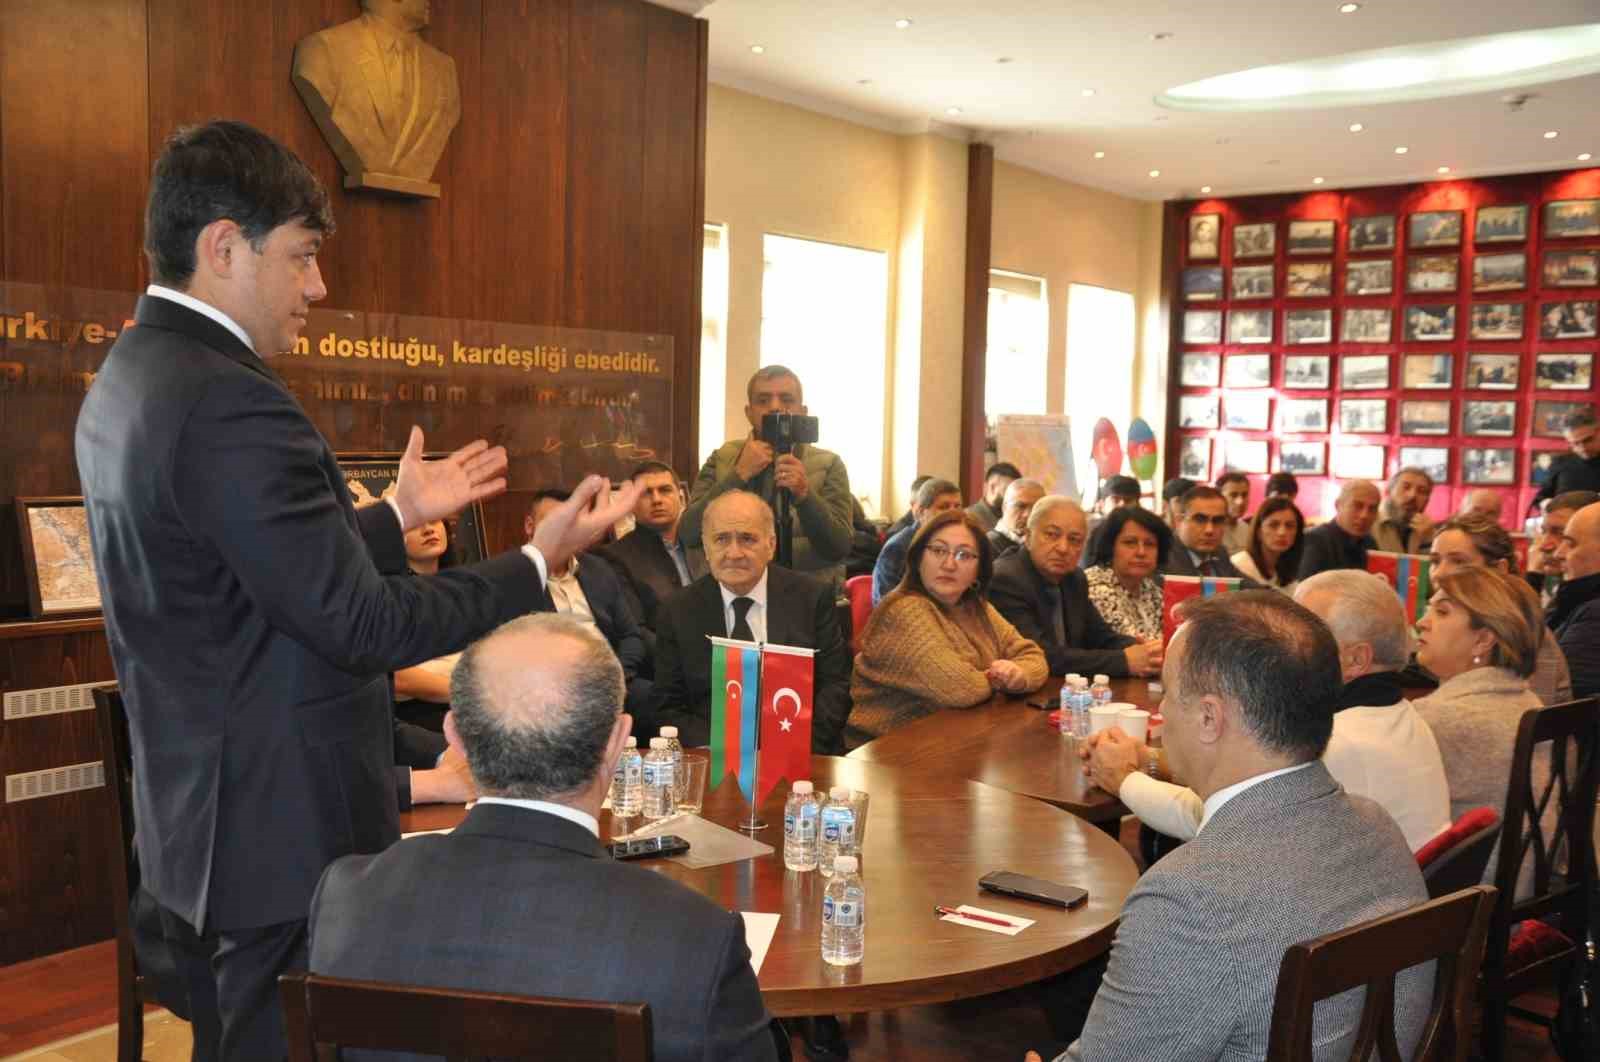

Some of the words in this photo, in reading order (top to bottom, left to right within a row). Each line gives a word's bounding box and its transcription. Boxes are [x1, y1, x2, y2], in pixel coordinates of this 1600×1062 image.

[319, 332, 444, 367] dostluğu,
[453, 341, 567, 373] kardeşliği
[574, 351, 660, 373] ebedidir.
